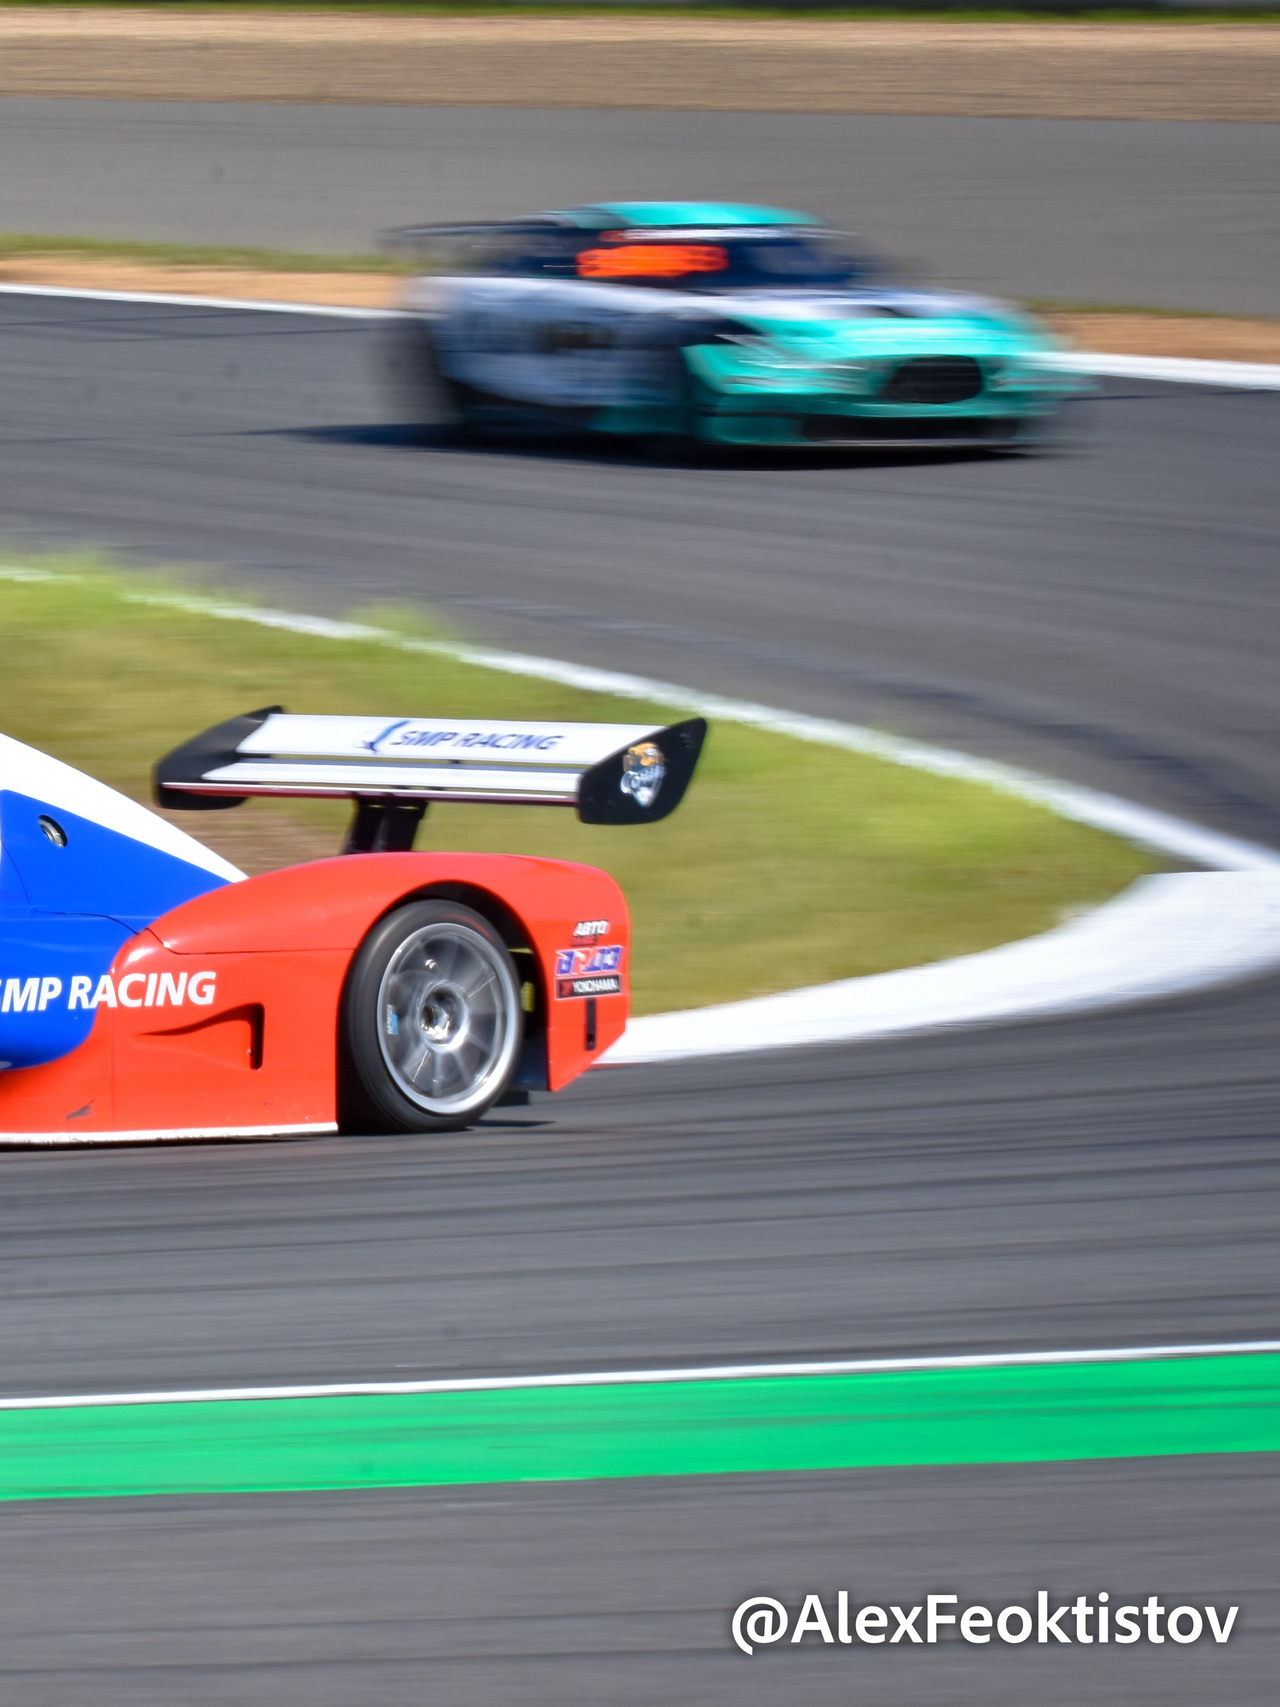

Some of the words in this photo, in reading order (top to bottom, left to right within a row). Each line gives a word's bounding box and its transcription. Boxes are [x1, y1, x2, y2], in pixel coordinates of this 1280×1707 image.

[390, 731, 458, 746] SMP
[453, 733, 566, 750] RACING
[67, 971, 217, 1009] RACING
